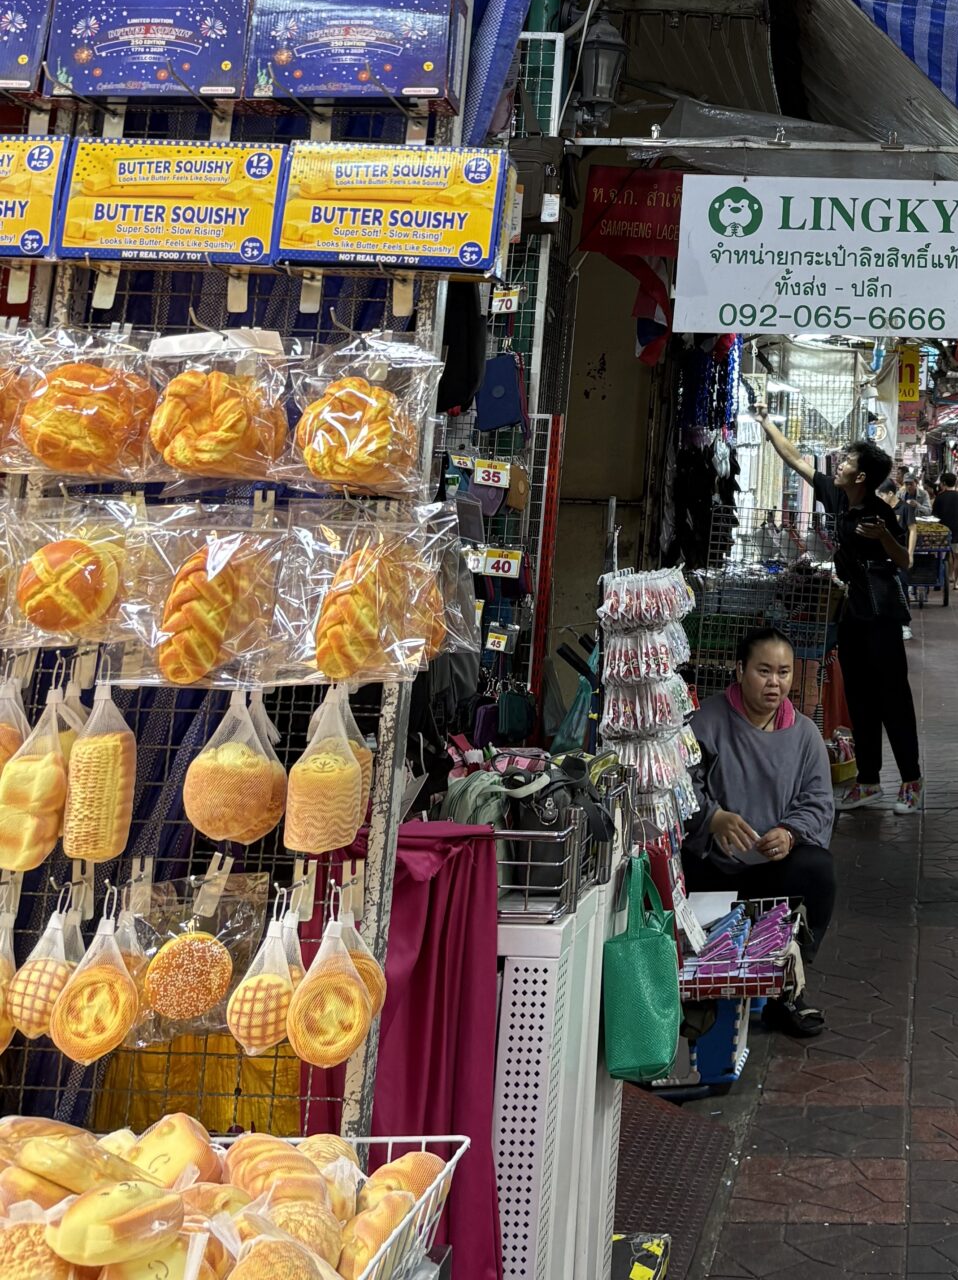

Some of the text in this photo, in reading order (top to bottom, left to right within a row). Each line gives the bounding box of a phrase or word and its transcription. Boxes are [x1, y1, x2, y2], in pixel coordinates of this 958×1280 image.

[32, 147, 50, 159] 12
[31, 160, 49, 168] PCS
[118, 160, 233, 175] BUTTER SQUISHY
[250, 155, 268, 167] 12
[468, 160, 487, 172] 12
[335, 164, 450, 179] BUTTER SQUISHY
[204, 175, 230, 183] Squishy!
[94, 203, 249, 226] BUTTER SQUISHY
[311, 206, 468, 230] BUTTER SQUISHY
[116, 224, 141, 235] Super
[144, 225, 163, 234] Soft!
[171, 226, 192, 235] Slow
[194, 227, 224, 237] Rising!
[333, 227, 359, 237] Super
[361, 228, 381, 237] Soft!
[389, 229, 410, 239] Slow
[412, 231, 442, 241] Rising!
[600, 219, 680, 240] SAMPHENG LACE
[24, 240, 39, 250] 3+
[100, 237, 236, 250] Looks like Butter Feels Like Squishy!
[317, 240, 454, 254] Looks like Butter Feels Like Squishy!
[122, 250, 135, 259] NOT
[136, 251, 157, 259] REAL
[159, 251, 180, 260] FOOD
[186, 252, 202, 260] TOY
[244, 248, 259, 257] 3+
[339, 253, 354, 262] NOT
[356, 254, 375, 262] REAL
[376, 255, 397, 263] FOOD
[403, 256, 420, 264] TOY
[462, 252, 478, 262] 3+
[709, 241, 958, 270] จำหน่ายกระเป๋าลิขสิทธิ์แท้
[774, 267, 827, 297] ทั้งส่ง
[851, 276, 893, 298] ปลีก
[497, 298, 513, 311] 70
[718, 302, 946, 332] 092-065-6666
[481, 469, 502, 483] 35
[490, 559, 512, 573] 40
[490, 640, 502, 649] 45
